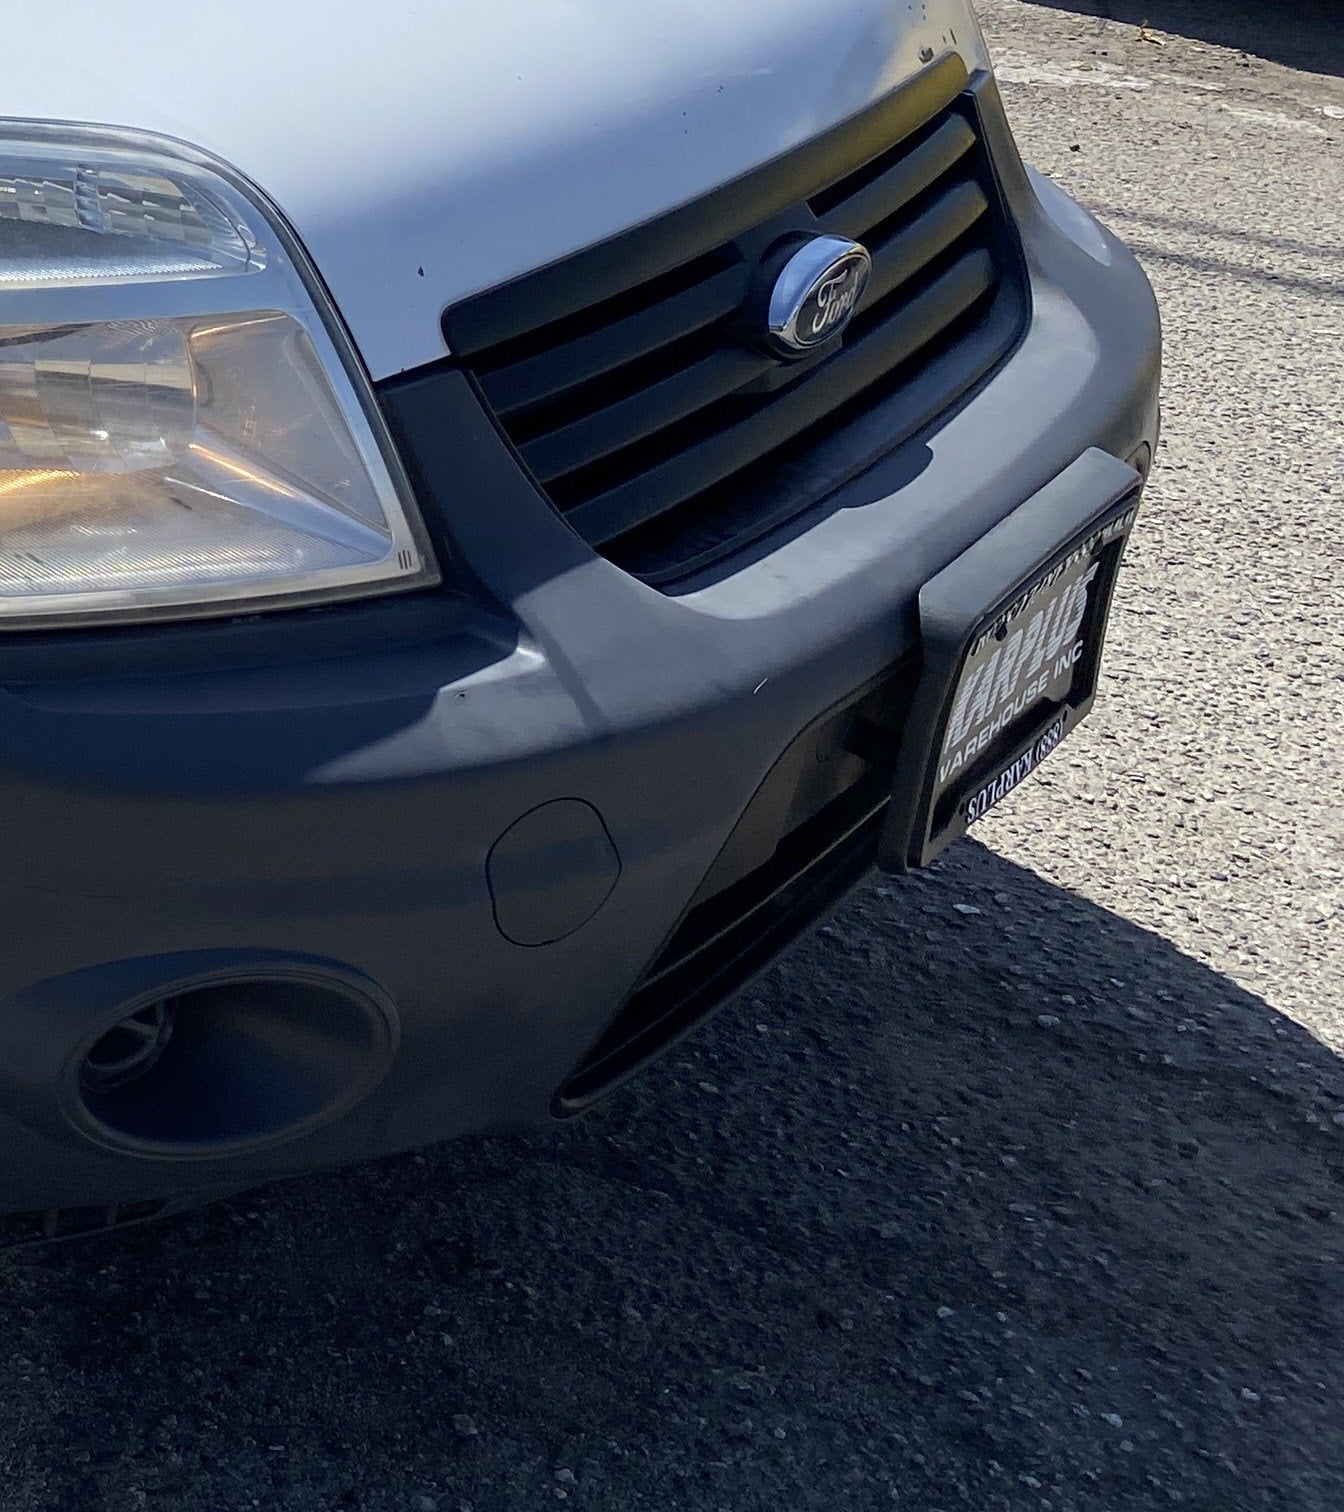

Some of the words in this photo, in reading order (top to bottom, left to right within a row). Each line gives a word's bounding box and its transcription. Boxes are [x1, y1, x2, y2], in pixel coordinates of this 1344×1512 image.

[813, 269, 859, 334] Ford
[1053, 639, 1084, 680] INC
[966, 747, 1034, 824] KARPLUS
